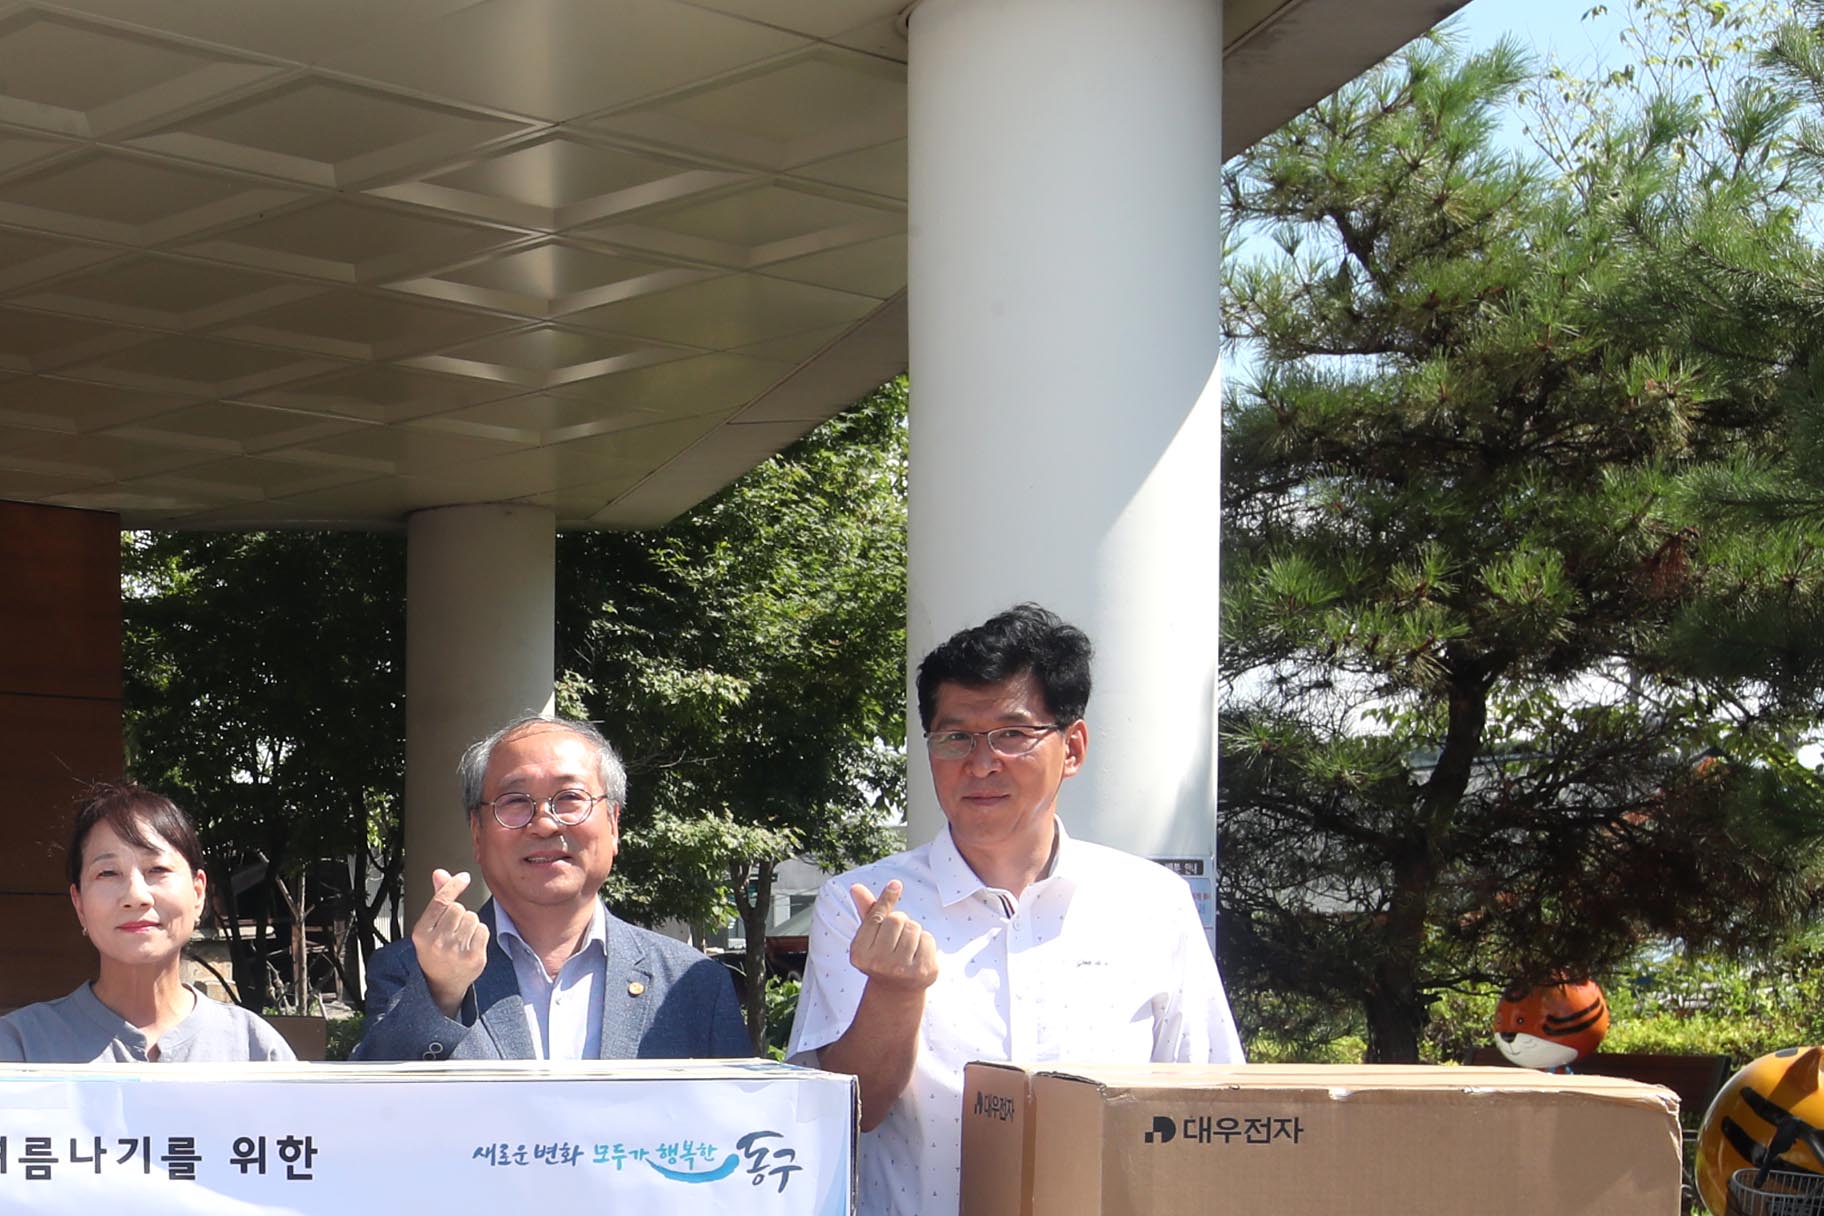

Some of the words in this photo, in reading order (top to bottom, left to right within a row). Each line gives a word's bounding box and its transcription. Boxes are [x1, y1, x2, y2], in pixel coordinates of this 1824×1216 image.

[983, 1095, 1015, 1122] 대우전자
[1182, 1116, 1304, 1144] 대우전자
[229, 1135, 318, 1180] 위한
[472, 1143, 530, 1166] 새로운
[533, 1143, 585, 1166] 변화
[592, 1143, 650, 1170] 모두가
[656, 1139, 719, 1170] 행복한
[736, 1130, 803, 1193] 동구
